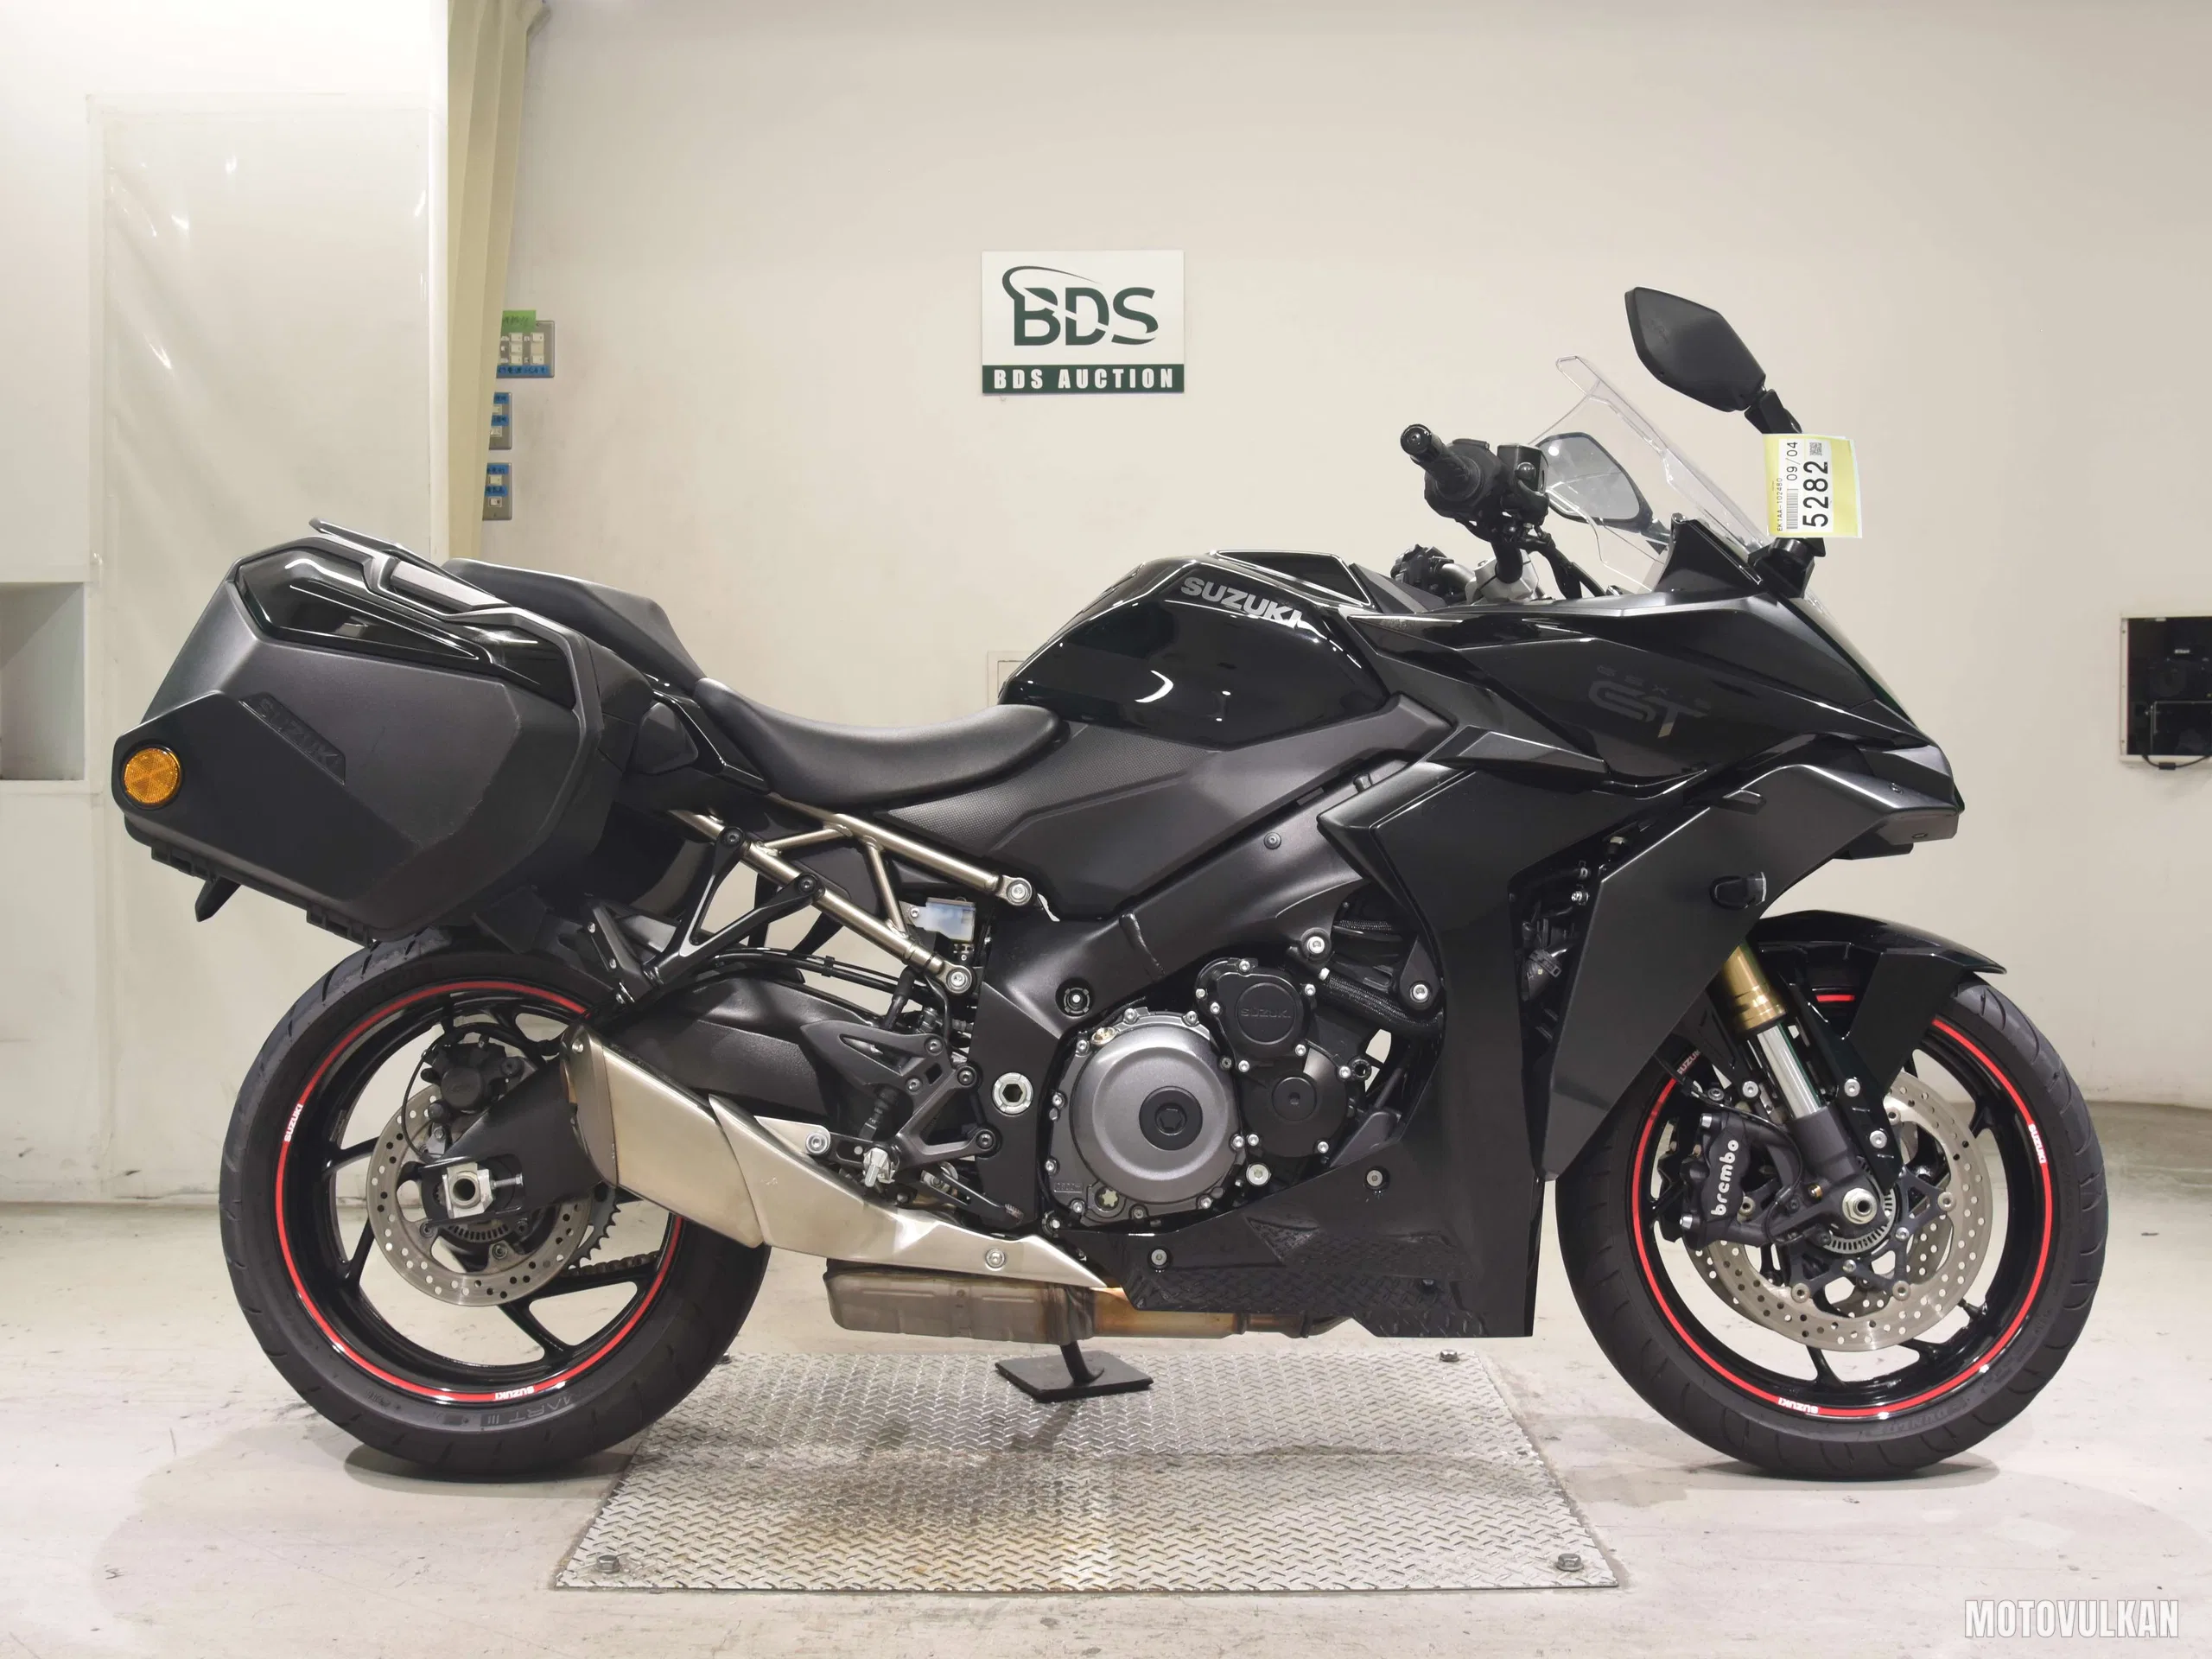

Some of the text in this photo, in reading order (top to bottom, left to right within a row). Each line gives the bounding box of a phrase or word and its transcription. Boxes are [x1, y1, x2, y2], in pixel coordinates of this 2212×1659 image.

[1002, 265, 1159, 346] BDS
[994, 368, 1173, 389] BDS AUCTION
[1785, 442, 1801, 481] 09/04
[1802, 461, 1829, 527] 5282
[1180, 576, 1303, 628] SUZUKI
[283, 1103, 304, 1142] SUZUKI
[1711, 1139, 1739, 1216] brembo
[494, 1385, 535, 1401] SUZUKI
[1777, 1396, 1819, 1415] SUZUKI
